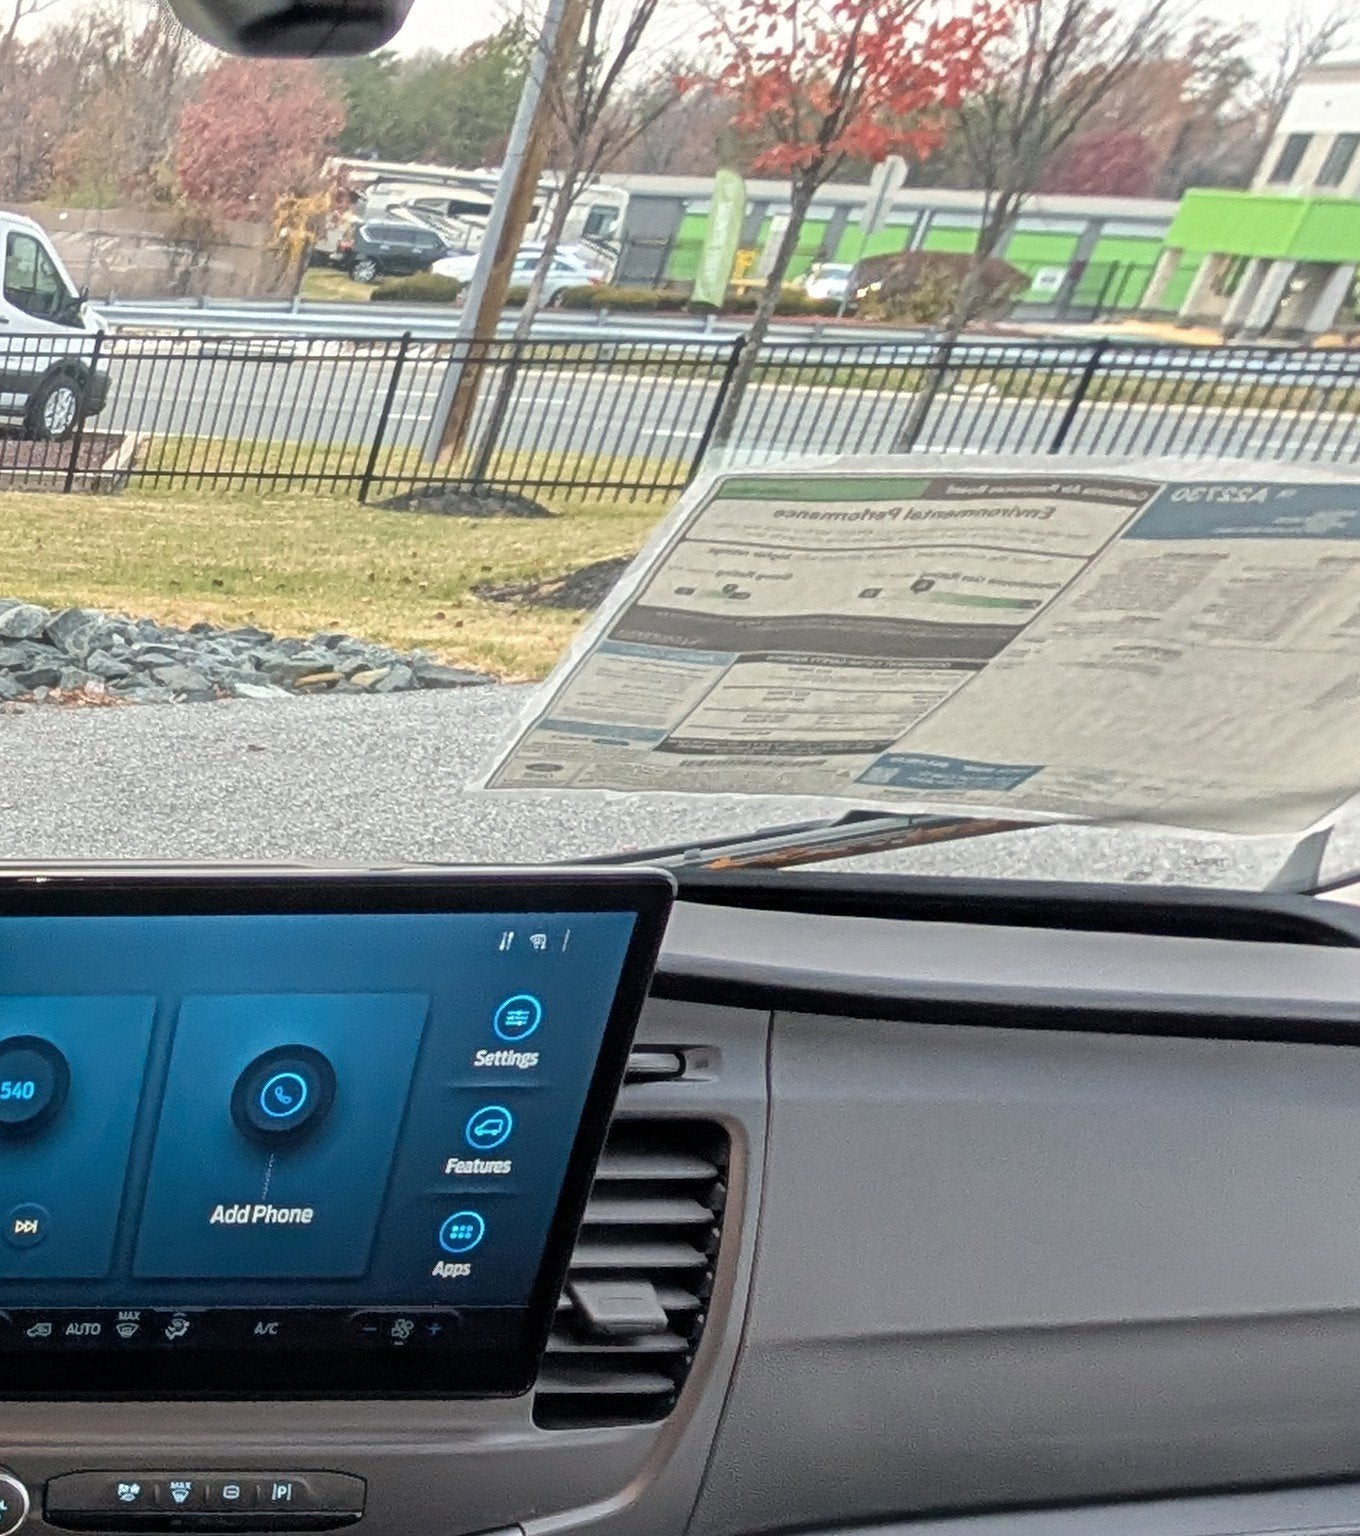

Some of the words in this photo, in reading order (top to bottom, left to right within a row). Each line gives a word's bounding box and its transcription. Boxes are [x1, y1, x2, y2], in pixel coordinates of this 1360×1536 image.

[473, 1049, 540, 1069] Settings
[0, 1081, 35, 1100] 540
[444, 1157, 512, 1174] Features
[209, 1204, 251, 1224] Add
[251, 1204, 314, 1224] Phone
[432, 1260, 471, 1278] Apps
[118, 1311, 141, 1321] MAX
[65, 1322, 101, 1336] AUTO
[254, 1321, 279, 1336] A/C
